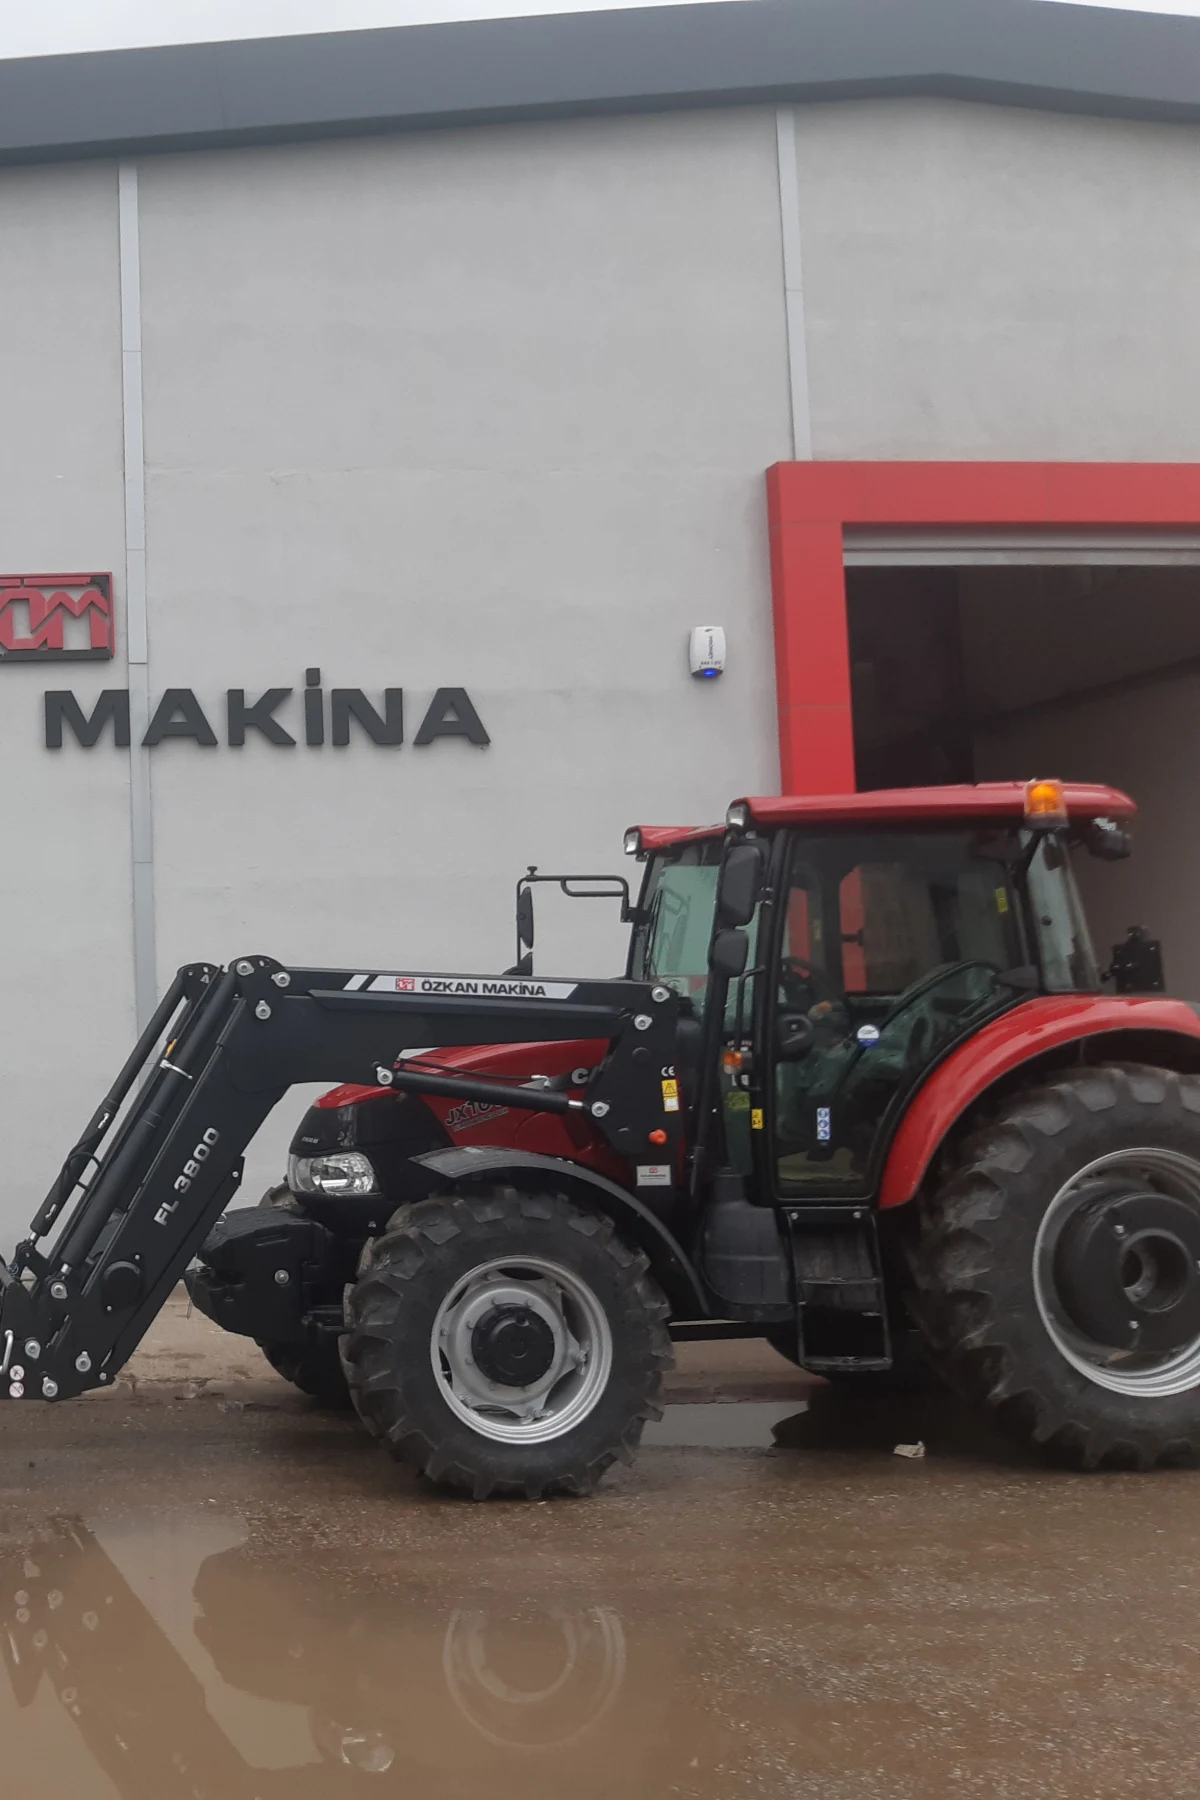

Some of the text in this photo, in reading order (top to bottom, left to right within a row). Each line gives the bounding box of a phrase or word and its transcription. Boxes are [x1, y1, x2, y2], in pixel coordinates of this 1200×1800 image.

[44, 667, 490, 749] MAKİNA
[421, 979, 479, 993] ÖZKAN
[482, 982, 546, 997] MAKİNA
[661, 1066, 675, 1076] CE
[445, 1100, 501, 1126] JX10
[153, 1127, 220, 1227] FL 3800
